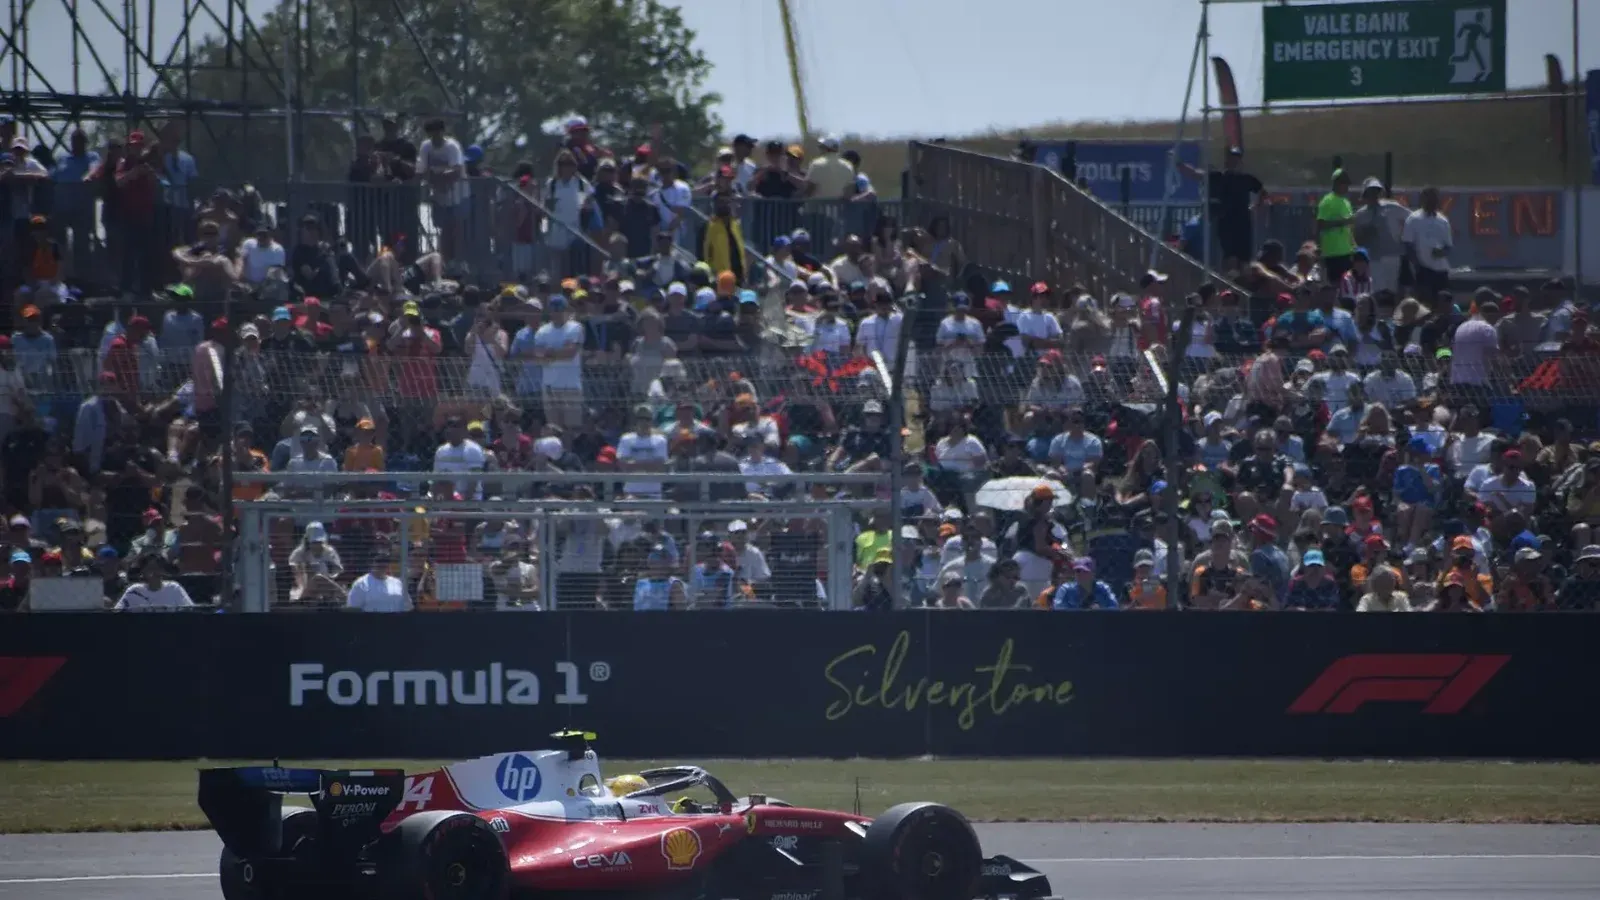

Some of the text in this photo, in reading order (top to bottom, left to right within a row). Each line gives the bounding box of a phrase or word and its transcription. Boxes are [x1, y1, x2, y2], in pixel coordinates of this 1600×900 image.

[1304, 12, 1410, 35] VALE BANK
[1273, 36, 1440, 62] EMERGENCY EXIT
[1350, 66, 1363, 86] 3
[289, 661, 541, 706] Formula
[824, 630, 1075, 730] Silverstone
[502, 753, 537, 802] hp
[343, 784, 390, 796] V-Power
[332, 802, 378, 815] PERONI
